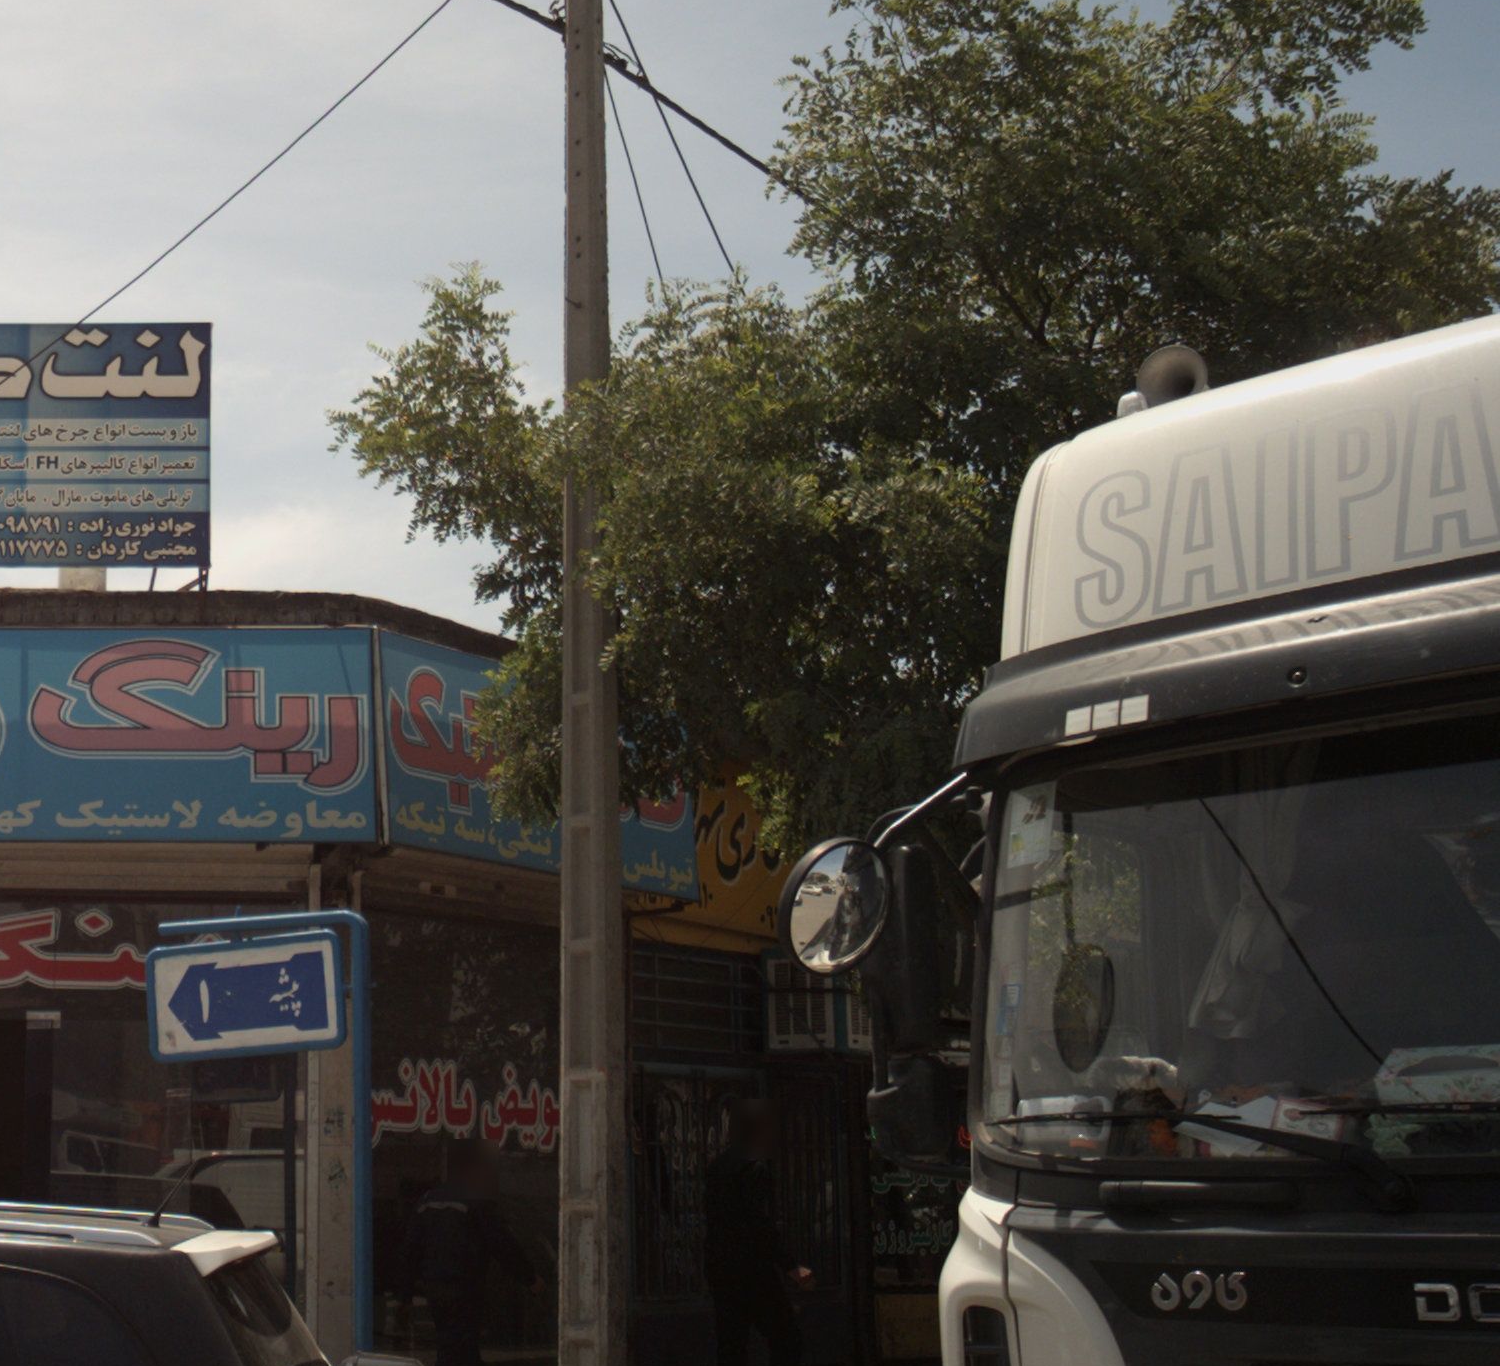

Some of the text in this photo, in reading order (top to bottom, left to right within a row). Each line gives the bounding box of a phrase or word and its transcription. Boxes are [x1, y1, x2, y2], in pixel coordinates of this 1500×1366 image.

[39, 327, 210, 401] لنت
[26, 423, 53, 442] های
[55, 424, 90, 444] چرخ
[93, 423, 127, 442] انواع
[128, 424, 170, 442] بست
[36, 455, 60, 470] FH
[127, 455, 160, 475] انواع
[161, 456, 197, 476] تعمیر
[130, 489, 154, 508] های
[1073, 381, 1500, 630] SAIPA
[78, 517, 113, 538] زاده
[114, 515, 156, 537] نوری
[157, 516, 197, 538] جواد
[142, 539, 197, 561] مجتبی
[28, 637, 369, 796] رینگ
[54, 799, 204, 836] لاستیک
[216, 800, 368, 837] معاوضه
[395, 801, 446, 843] تیکه
